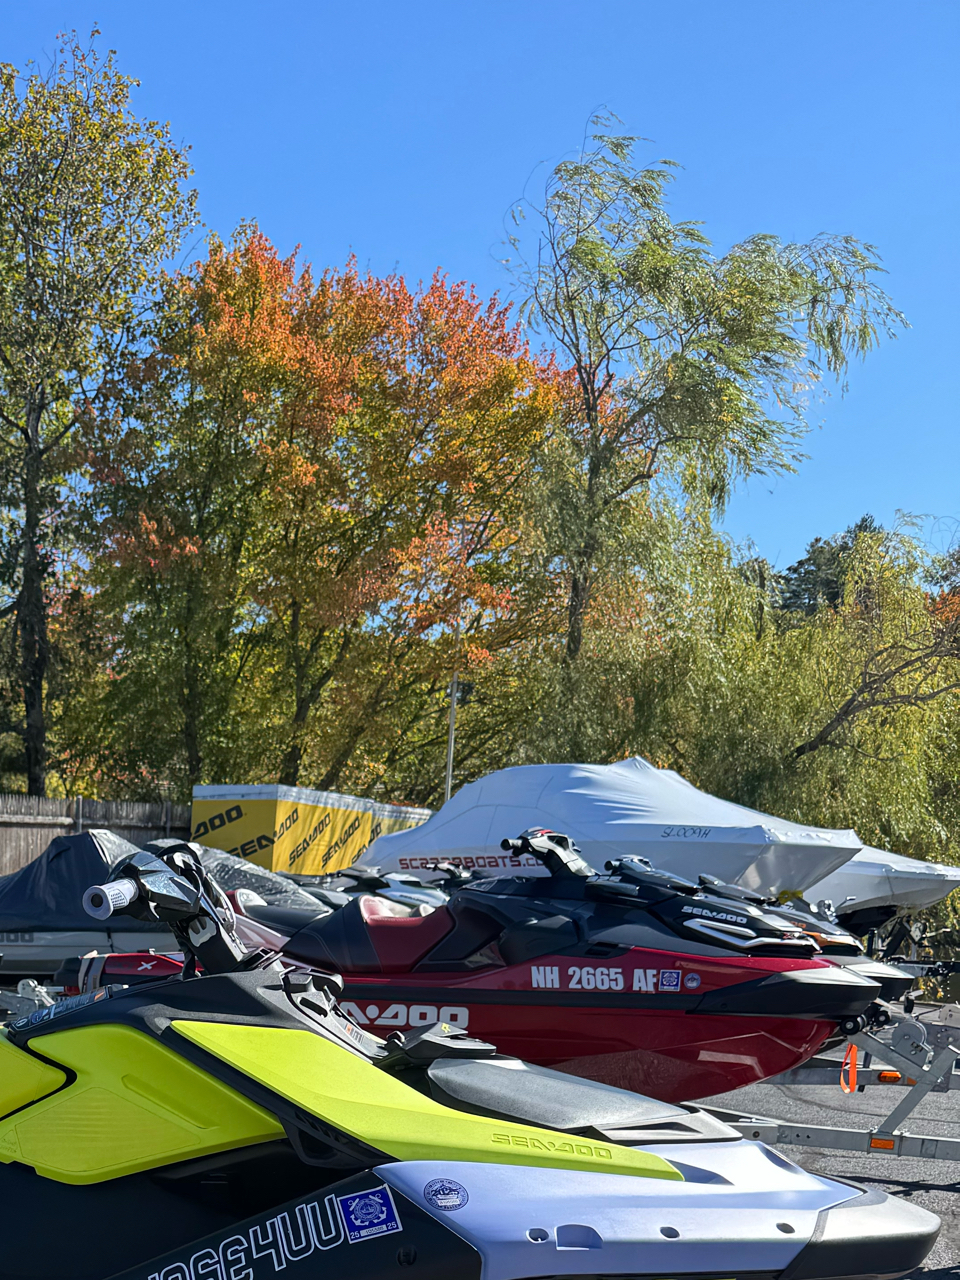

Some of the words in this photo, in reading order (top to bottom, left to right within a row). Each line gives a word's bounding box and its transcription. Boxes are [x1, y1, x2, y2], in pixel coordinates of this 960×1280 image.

[192, 805, 243, 840] DOO
[531, 966, 559, 988] NH
[567, 966, 624, 990] 2665
[632, 968, 657, 991] AF
[387, 1221, 397, 1230] 25
[350, 1231, 360, 1239] 25
